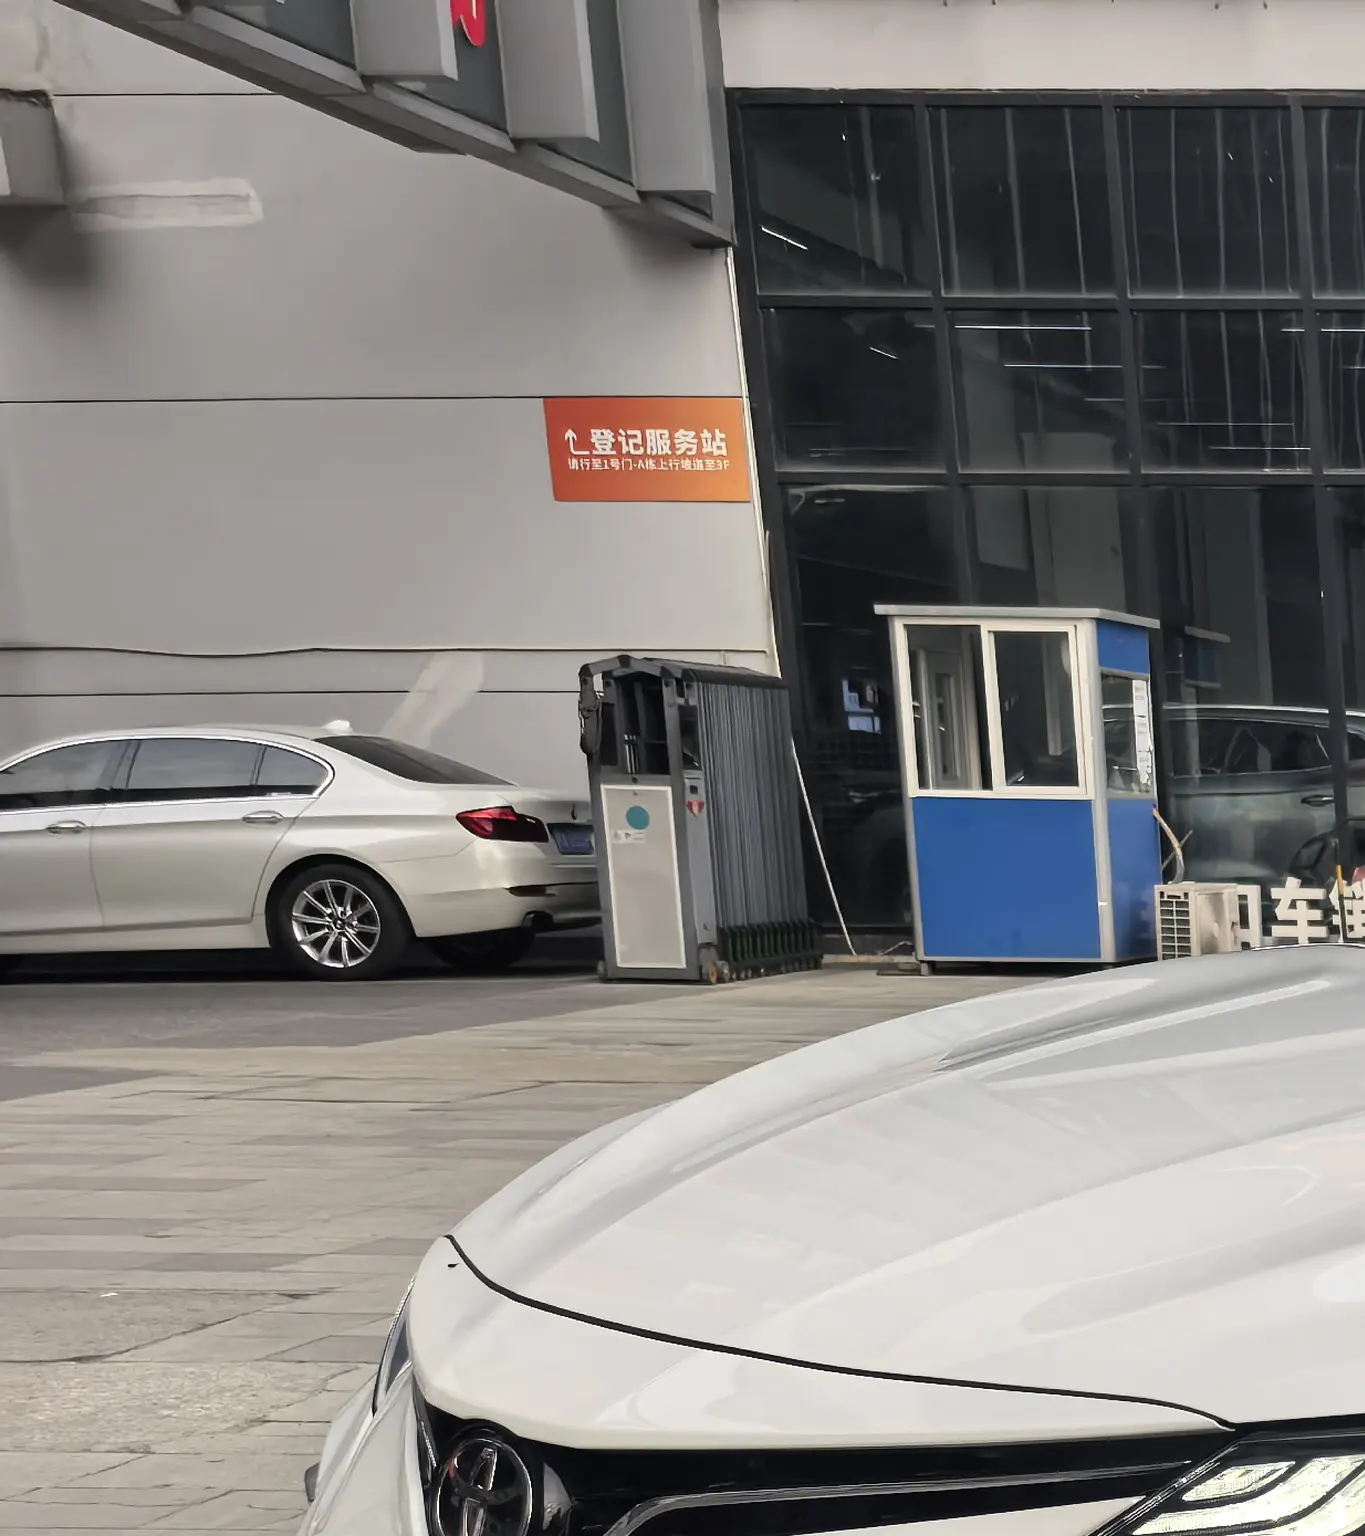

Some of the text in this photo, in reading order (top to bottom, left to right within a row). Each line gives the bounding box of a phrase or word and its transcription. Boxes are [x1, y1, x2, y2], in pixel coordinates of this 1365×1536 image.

[590, 428, 728, 457] 登记服务站
